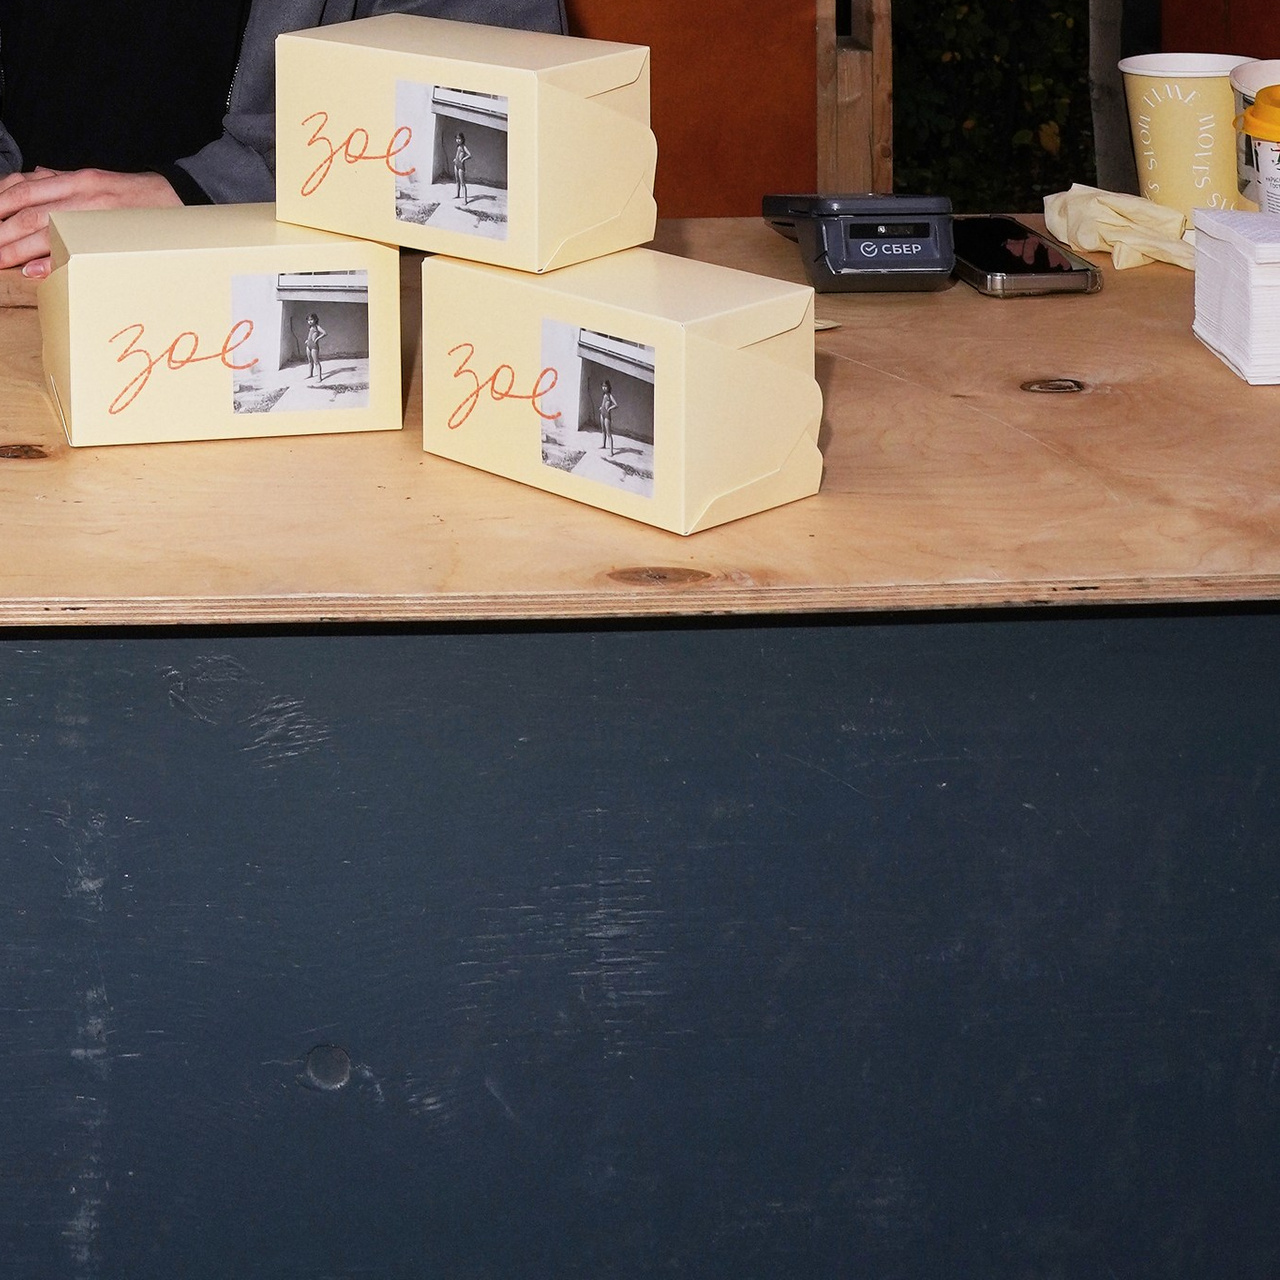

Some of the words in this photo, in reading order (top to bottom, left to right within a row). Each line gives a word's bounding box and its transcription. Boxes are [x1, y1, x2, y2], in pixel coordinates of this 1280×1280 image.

[1142, 83, 1200, 108] TIME
[300, 111, 417, 197] zoe
[881, 244, 922, 255] СБЕР
[108, 318, 260, 416] zoe
[446, 342, 563, 431] zoe
